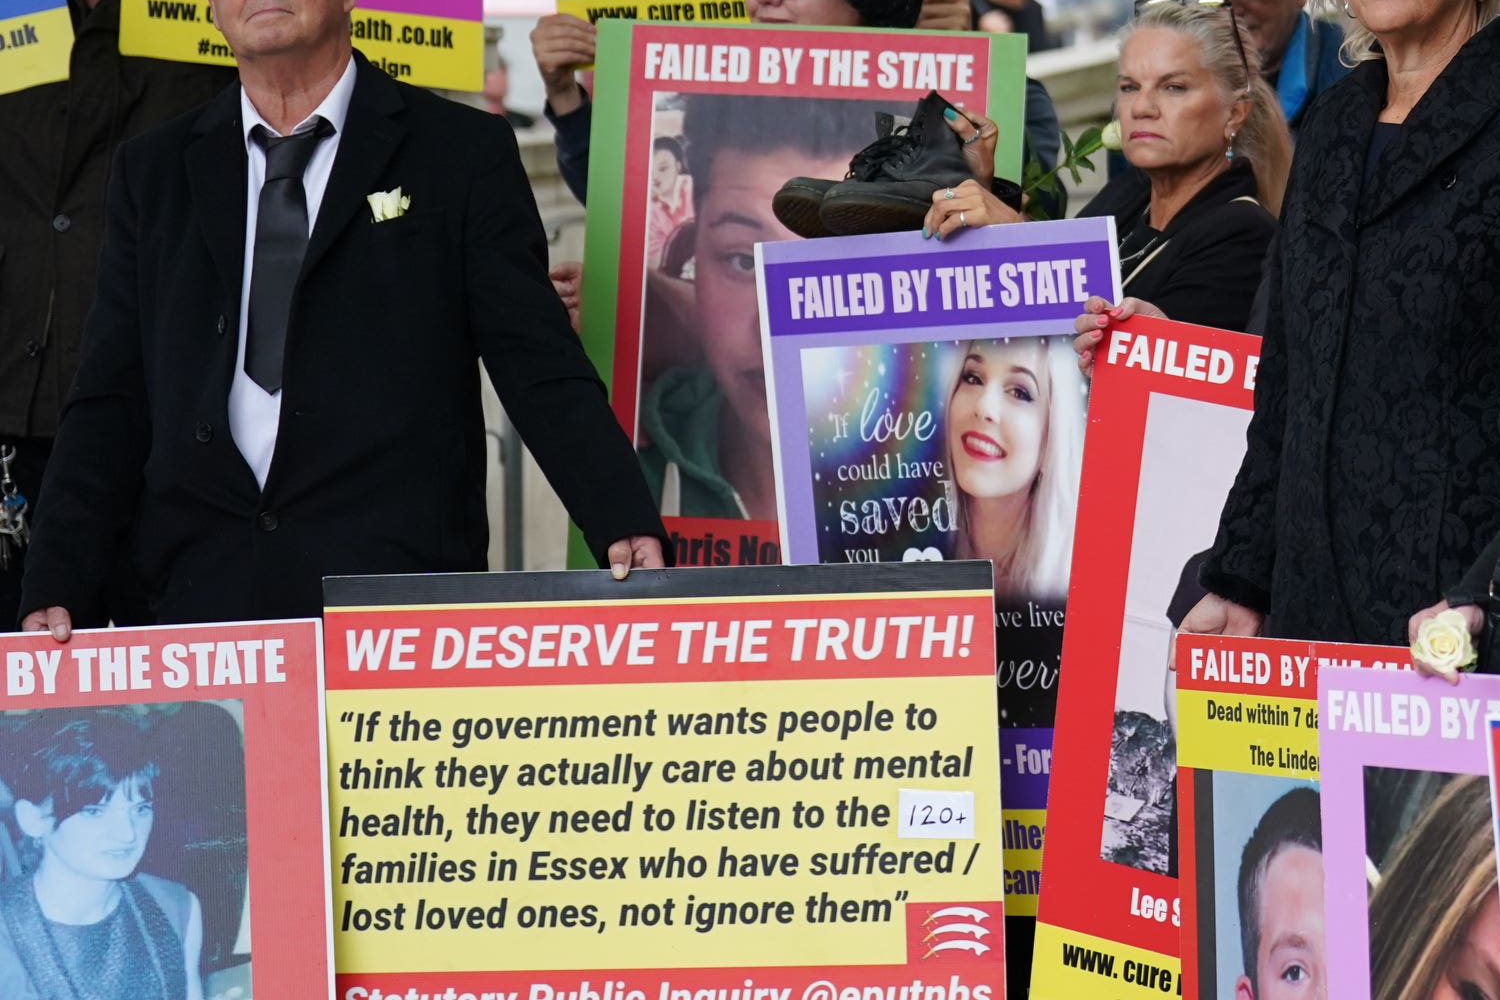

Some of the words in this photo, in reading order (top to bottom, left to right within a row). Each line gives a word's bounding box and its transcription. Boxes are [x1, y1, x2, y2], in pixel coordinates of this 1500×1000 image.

[147, 0, 200, 23] www.
[647, 2, 695, 21] cure
[396, 26, 453, 49] .co.uk
[645, 43, 750, 83] FAILED
[758, 47, 803, 85] BY
[809, 49, 868, 88] THE
[877, 51, 974, 92] STATE
[788, 272, 885, 320] FAILED
[891, 269, 930, 313] BY
[936, 265, 994, 311] THE
[998, 259, 1089, 308] STATE
[1107, 330, 1234, 384] FAILED
[833, 412, 849, 439] If
[860, 387, 936, 442] love
[837, 454, 891, 482] could
[897, 453, 943, 479] have
[840, 480, 960, 535] saved
[671, 531, 732, 566] hris
[346, 628, 420, 671] WE
[431, 622, 659, 669] DESERVE
[670, 619, 772, 664] THE
[784, 615, 974, 661] TRUTH!
[6, 650, 62, 696] BY
[71, 645, 152, 693] THE
[161, 639, 286, 689] STATE
[1190, 648, 1271, 685] FAILED
[1280, 655, 1310, 688] BY
[389, 710, 442, 742] the
[452, 709, 657, 748] government
[667, 707, 768, 736] wants
[777, 700, 894, 741] people
[905, 703, 937, 730] to
[1207, 699, 1242, 723] Dead
[1246, 703, 1289, 727] within
[1293, 706, 1302, 727] 7
[1327, 689, 1431, 738] FAILED
[1440, 696, 1481, 741] BY
[339, 757, 425, 790] think
[435, 757, 508, 795] they
[517, 753, 653, 792] actually
[662, 758, 736, 783] care
[746, 750, 844, 782] about
[854, 746, 973, 780] mental
[1250, 744, 1274, 767] The
[339, 804, 452, 842] health,
[466, 803, 540, 842] they
[549, 801, 633, 833] need
[643, 804, 675, 832] to
[686, 799, 780, 830] listen
[793, 801, 824, 828] to
[836, 796, 891, 828] the
[909, 804, 967, 827] 120+
[341, 851, 477, 885] families
[487, 851, 517, 882] in
[528, 850, 628, 881] Essex
[639, 847, 708, 878] who
[717, 846, 799, 877] have
[809, 842, 956, 875] suffered
[341, 899, 406, 931] lost
[414, 898, 508, 930] loved
[517, 904, 606, 934] ones,
[618, 898, 675, 926] not
[685, 895, 795, 933] ignore
[1130, 887, 1168, 922] Lee
[1063, 942, 1117, 979] www.
[1123, 959, 1172, 993] cure
